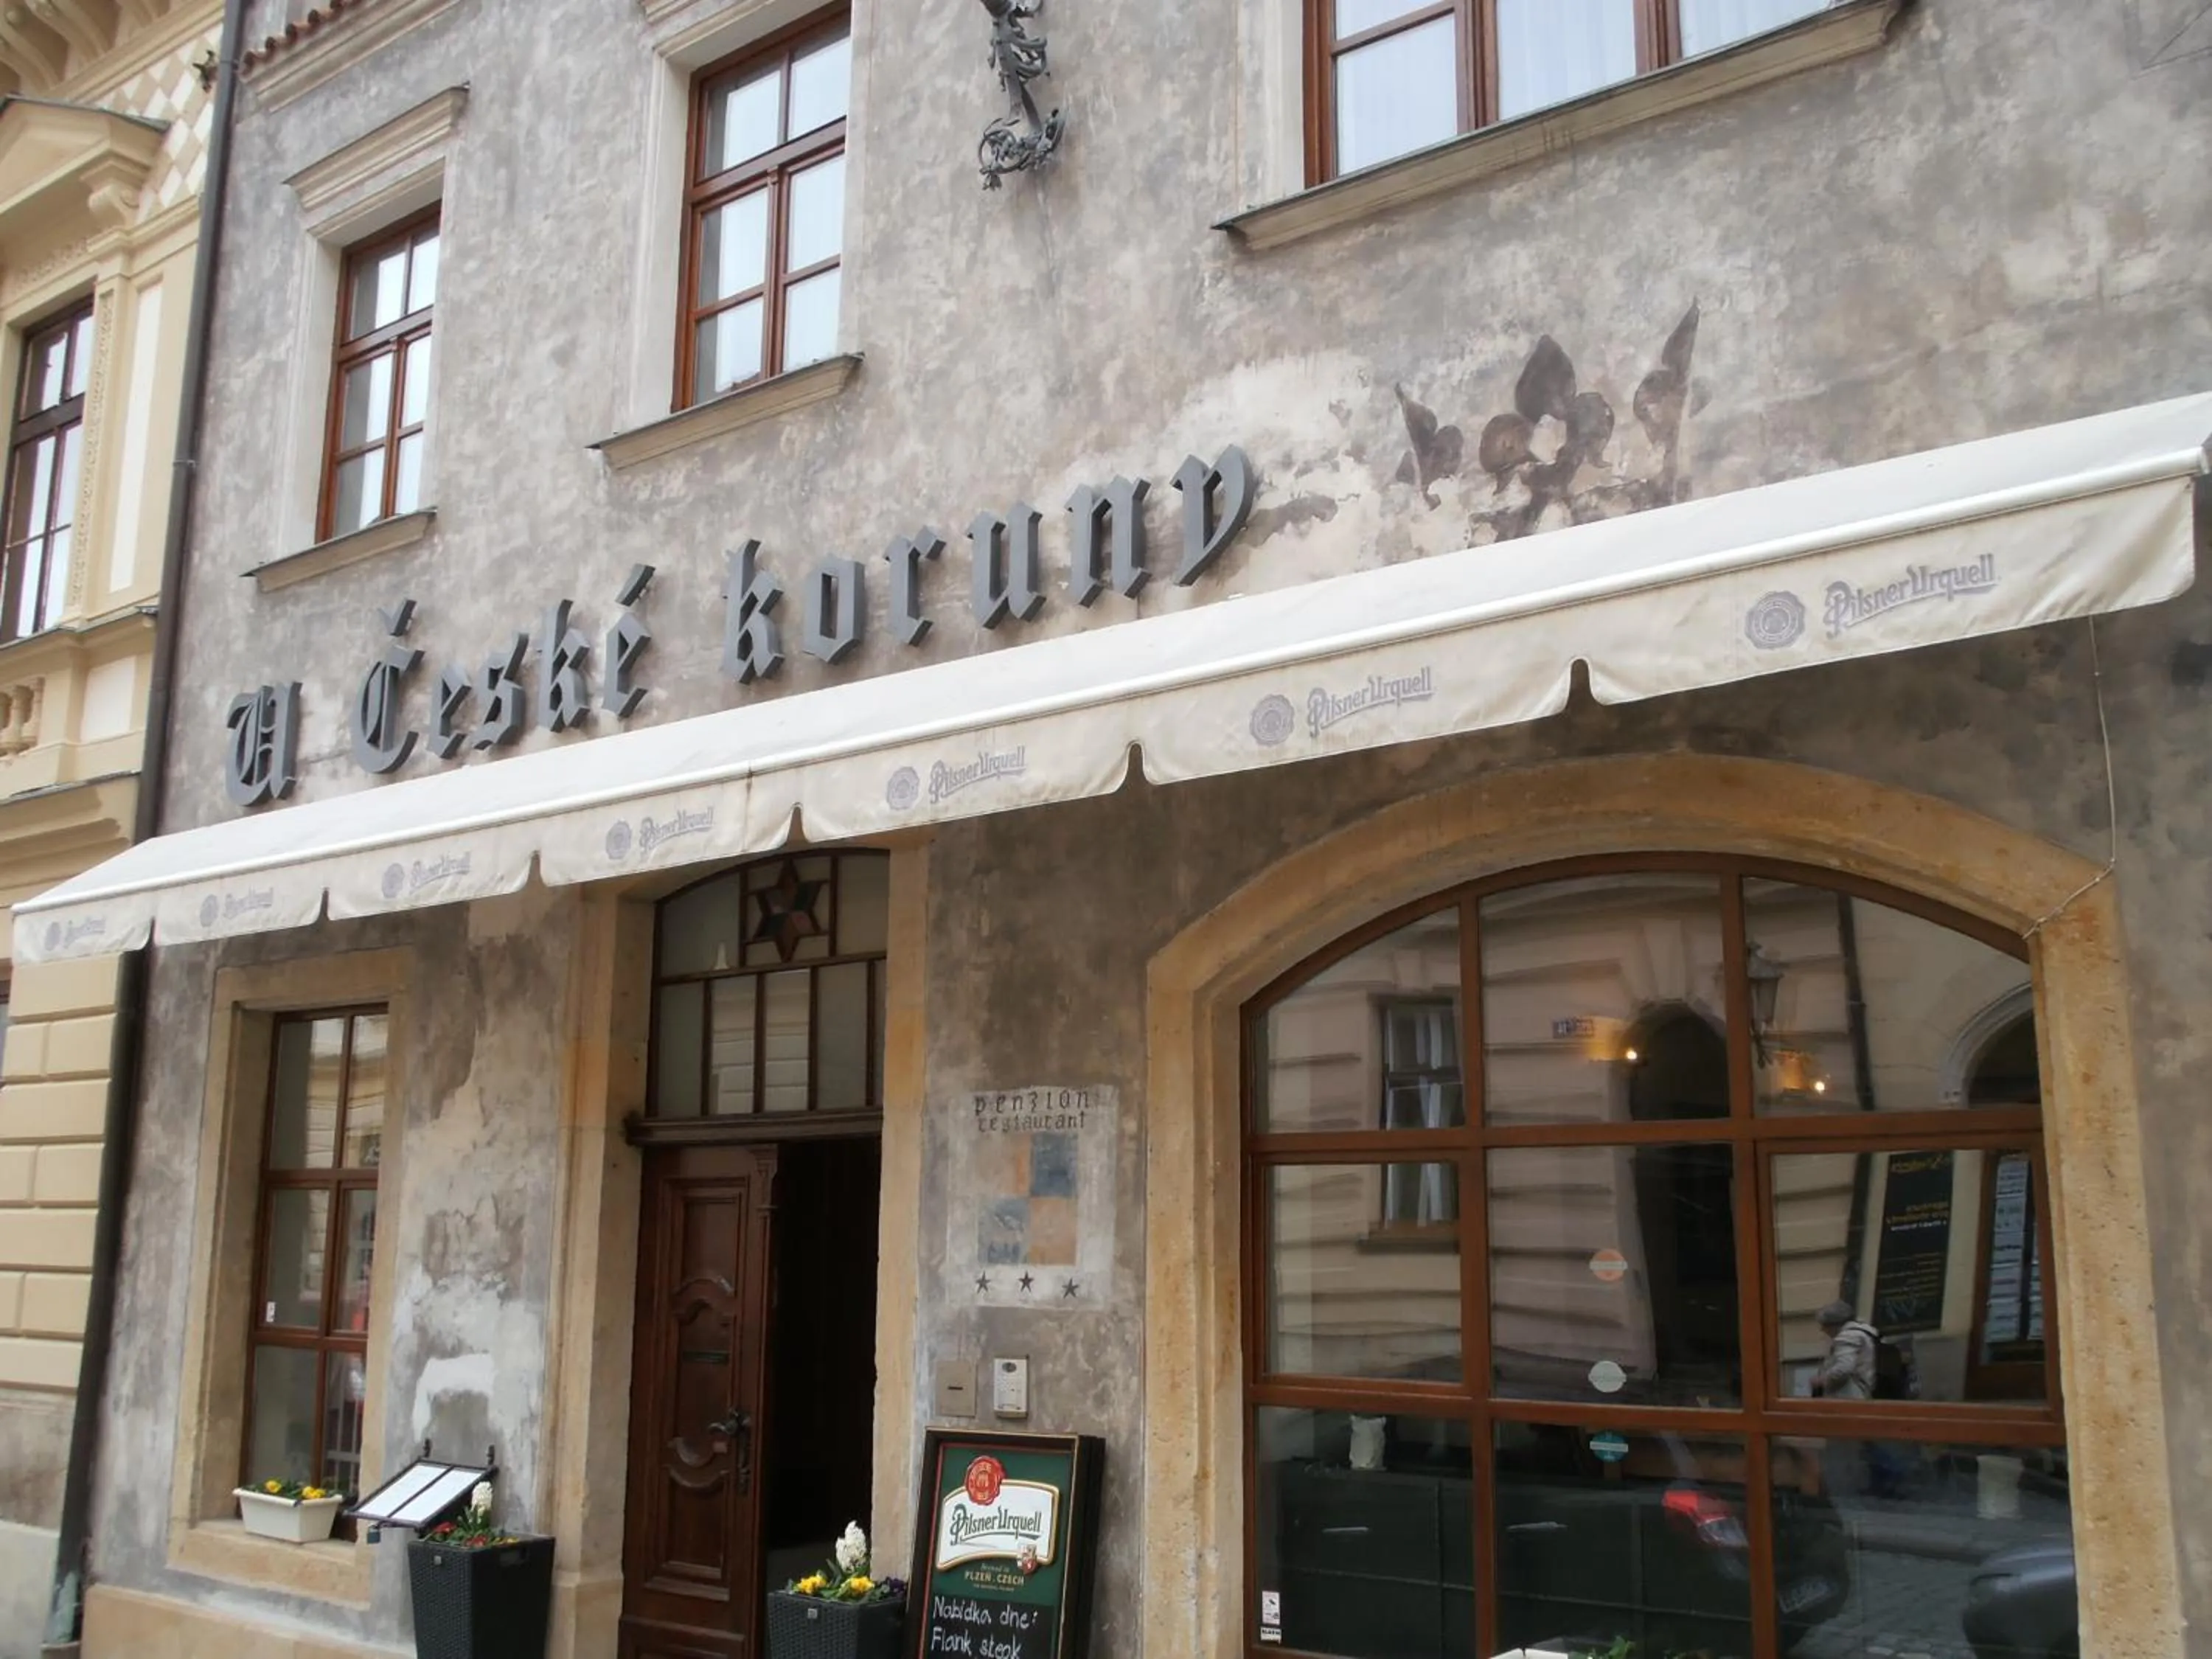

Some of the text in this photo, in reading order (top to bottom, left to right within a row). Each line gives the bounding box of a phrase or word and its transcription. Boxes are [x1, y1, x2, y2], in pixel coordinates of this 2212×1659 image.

[1822, 579, 1910, 640] Pilsner
[1906, 553, 1995, 601] Urquell
[225, 681, 302, 807] U
[350, 563, 656, 773] České
[1307, 665, 1431, 737] Pilsner Urquell
[978, 1110, 1085, 1133] restaurant
[950, 1503, 1042, 1546] Pilsner Urquell
[931, 1626, 973, 1656] Flank
